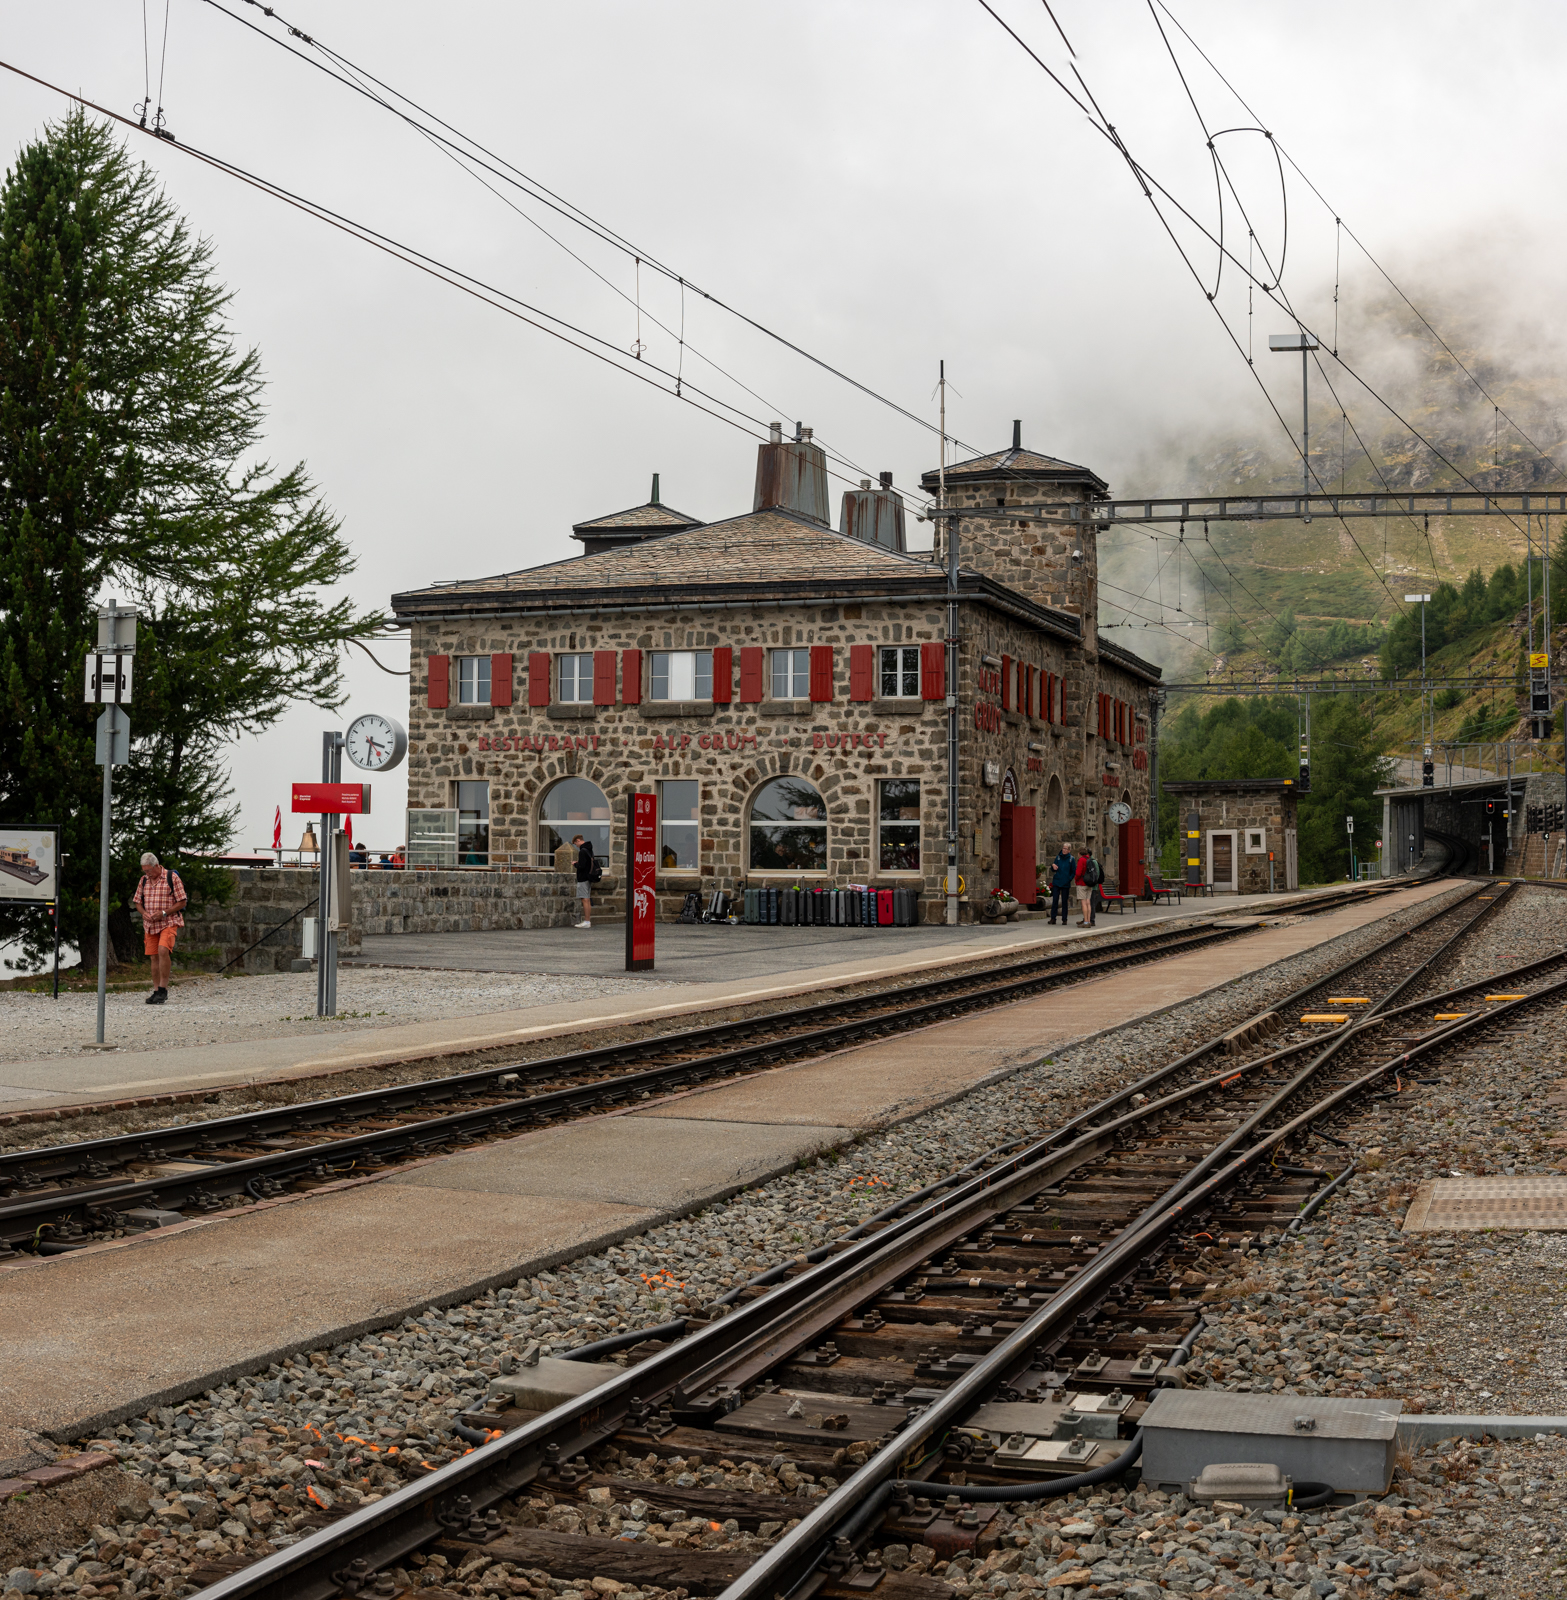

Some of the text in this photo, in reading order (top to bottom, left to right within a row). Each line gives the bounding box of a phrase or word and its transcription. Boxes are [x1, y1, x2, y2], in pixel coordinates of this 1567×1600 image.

[974, 700, 1001, 735] GRÜM
[478, 732, 888, 751] RESTAURANT ALP GRÜM BUFFET
[635, 851, 655, 865] Alp Grüm
